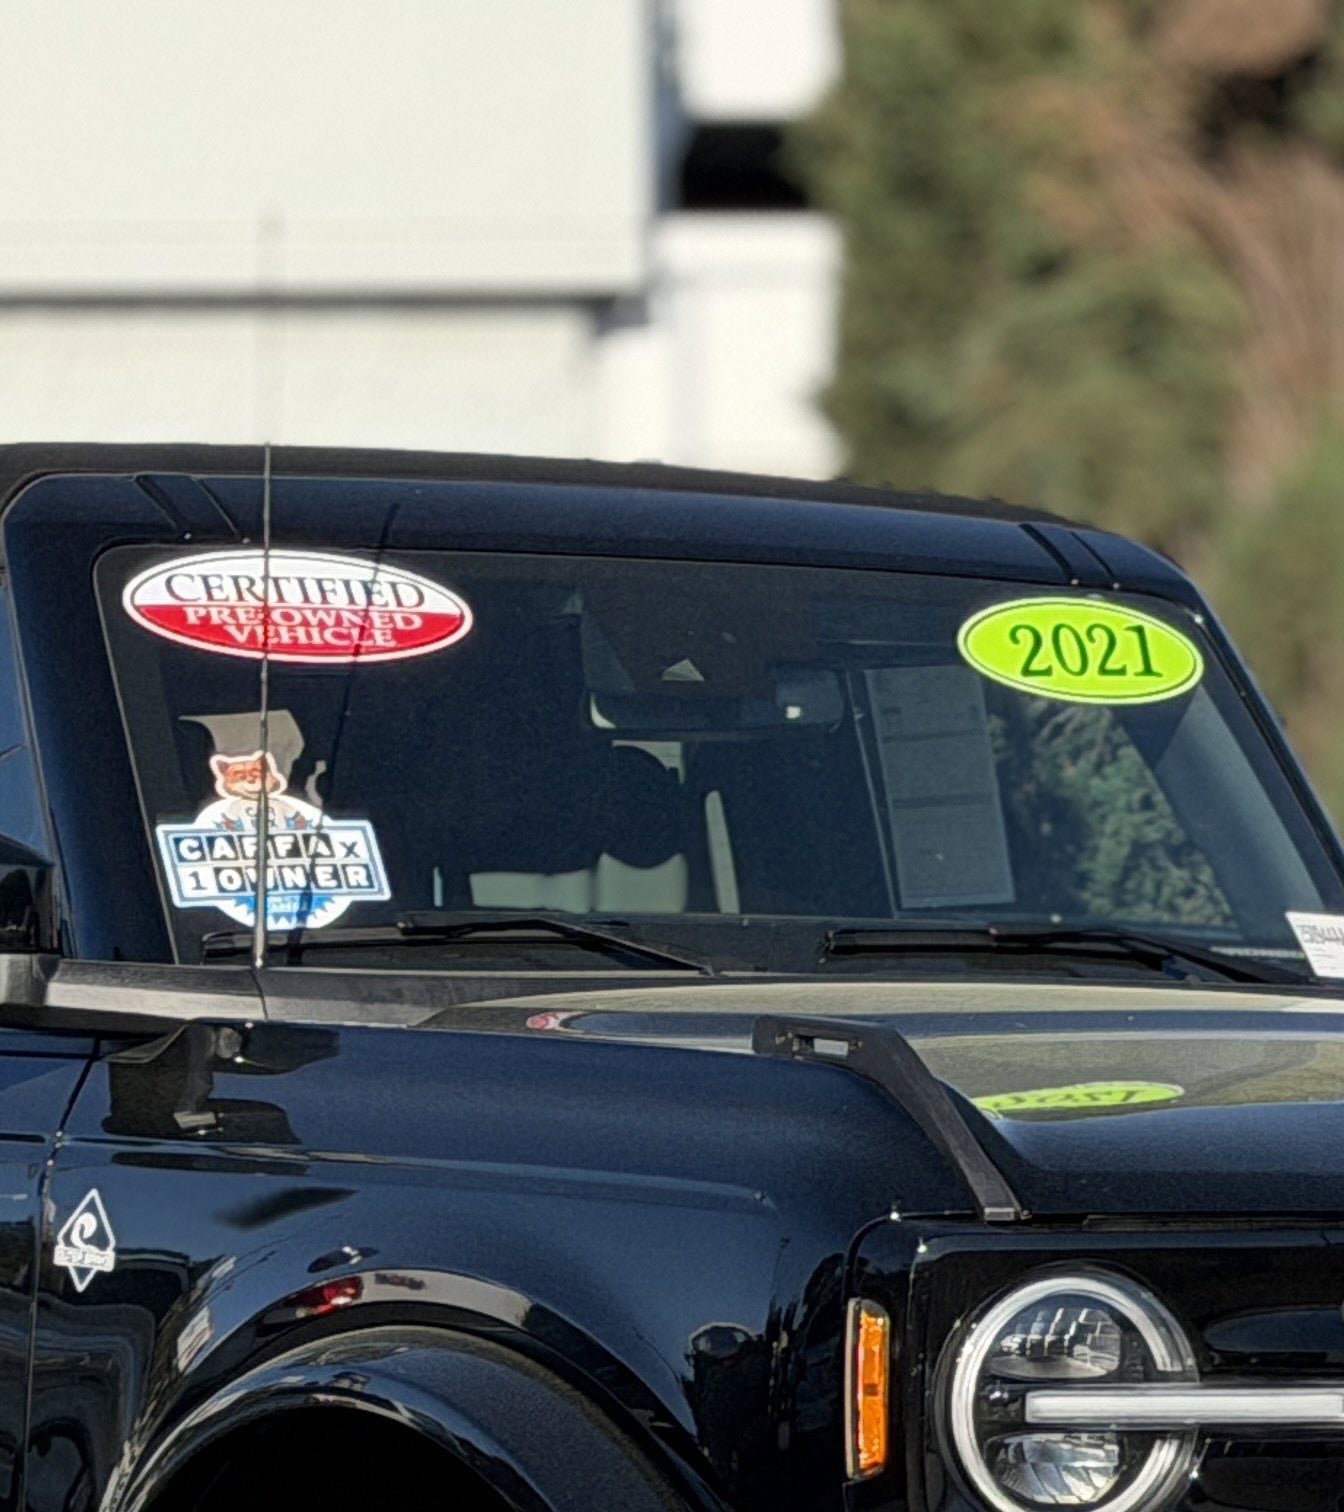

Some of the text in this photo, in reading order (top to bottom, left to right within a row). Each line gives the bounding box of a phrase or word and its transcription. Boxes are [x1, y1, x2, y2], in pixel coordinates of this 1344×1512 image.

[164, 573, 425, 609] CERTIFIED
[223, 624, 397, 647] VEHICLE
[1009, 623, 1164, 677] 2021
[178, 834, 363, 861] CARFAX
[218, 866, 370, 891] OWNER
